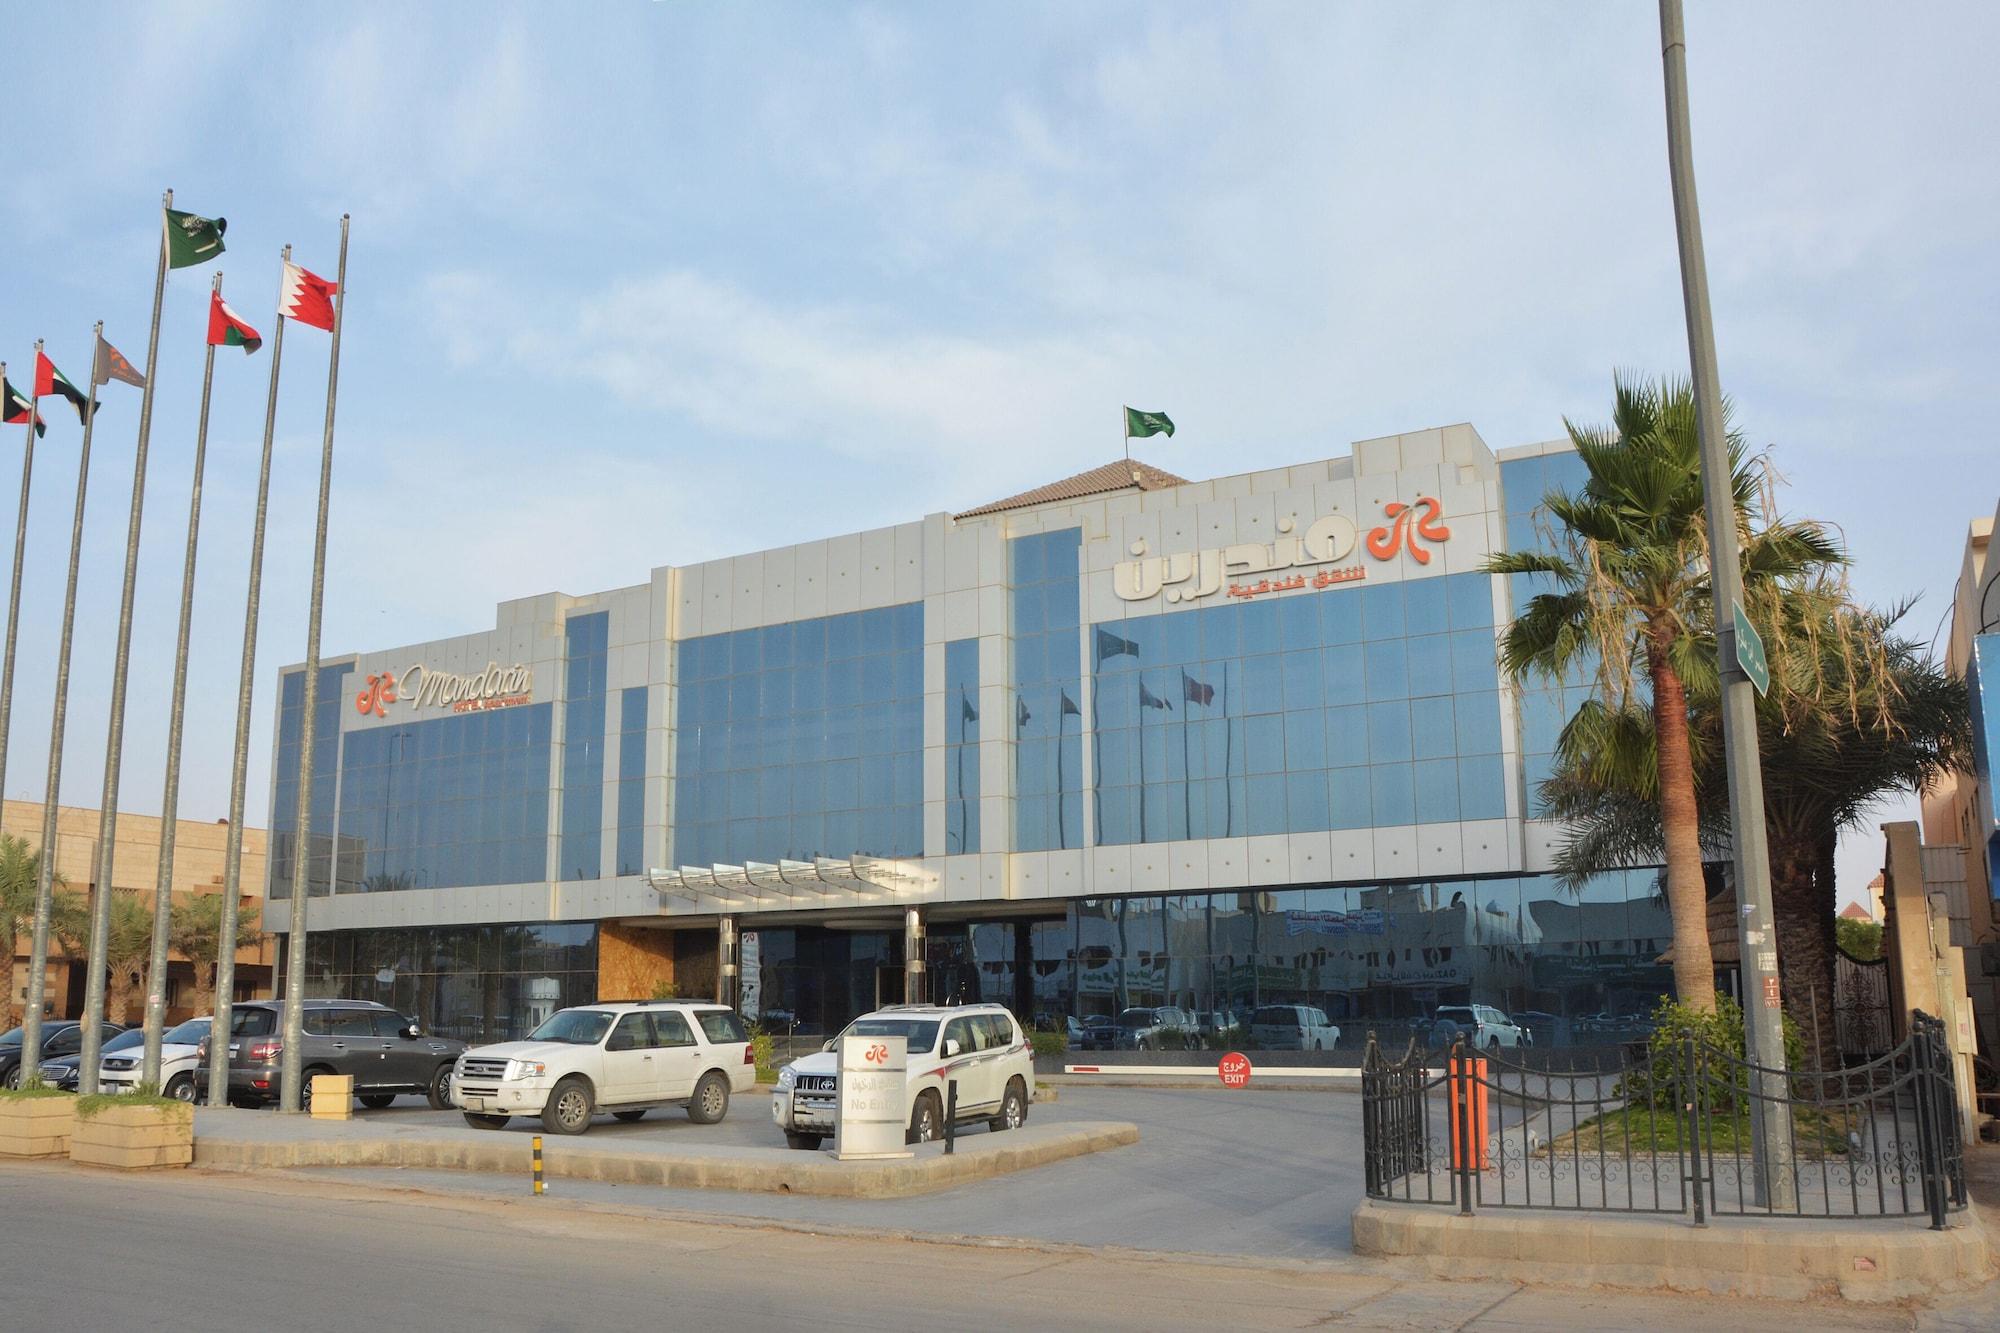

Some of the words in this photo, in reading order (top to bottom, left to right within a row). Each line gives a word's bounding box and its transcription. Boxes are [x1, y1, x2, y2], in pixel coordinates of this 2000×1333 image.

[1226, 574, 1306, 599] فندقية
[398, 661, 532, 710] Mandarin
[1223, 1058, 1246, 1073] خروج
[1224, 1074, 1246, 1084] EXIT
[851, 1098, 867, 1110] No
[869, 1098, 901, 1112] Entry
